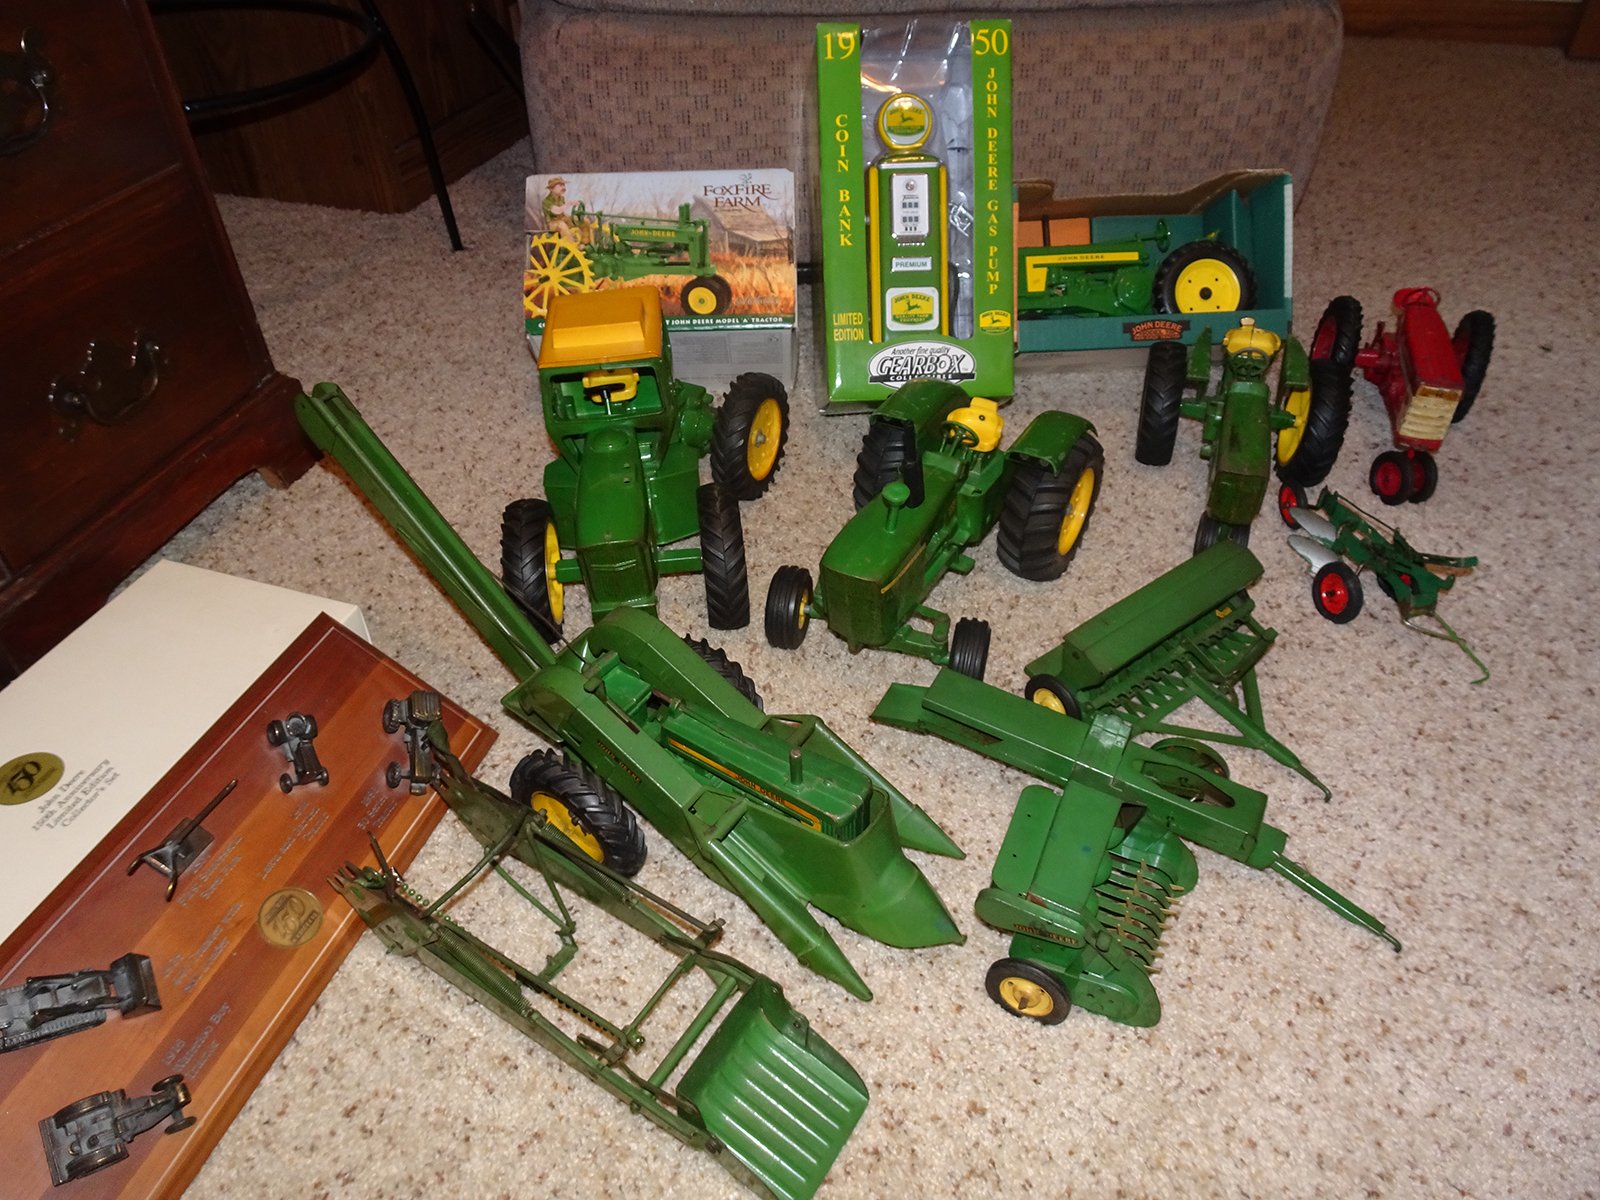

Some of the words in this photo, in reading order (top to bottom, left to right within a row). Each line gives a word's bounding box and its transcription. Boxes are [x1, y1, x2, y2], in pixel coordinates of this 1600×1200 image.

[823, 31, 855, 60] 19
[974, 28, 1009, 56] 50
[985, 67, 998, 118] JOHN
[835, 113, 849, 173] COIN
[987, 127, 998, 191] DEERE
[714, 196, 762, 213] FARM
[838, 188, 853, 247] BANK
[986, 199, 999, 237] GAS
[895, 260, 928, 269] PREMIUM
[986, 245, 1000, 295] PUMP
[715, 317, 740, 325] MODEL
[833, 312, 864, 326] LIMITED
[1132, 321, 1154, 335] JOHN
[1154, 320, 1182, 332] DEERE
[833, 328, 864, 342] EDITION
[891, 347, 916, 355] Another
[916, 346, 928, 355] fine
[928, 345, 951, 356] quality
[877, 353, 966, 376] GEARBOX
